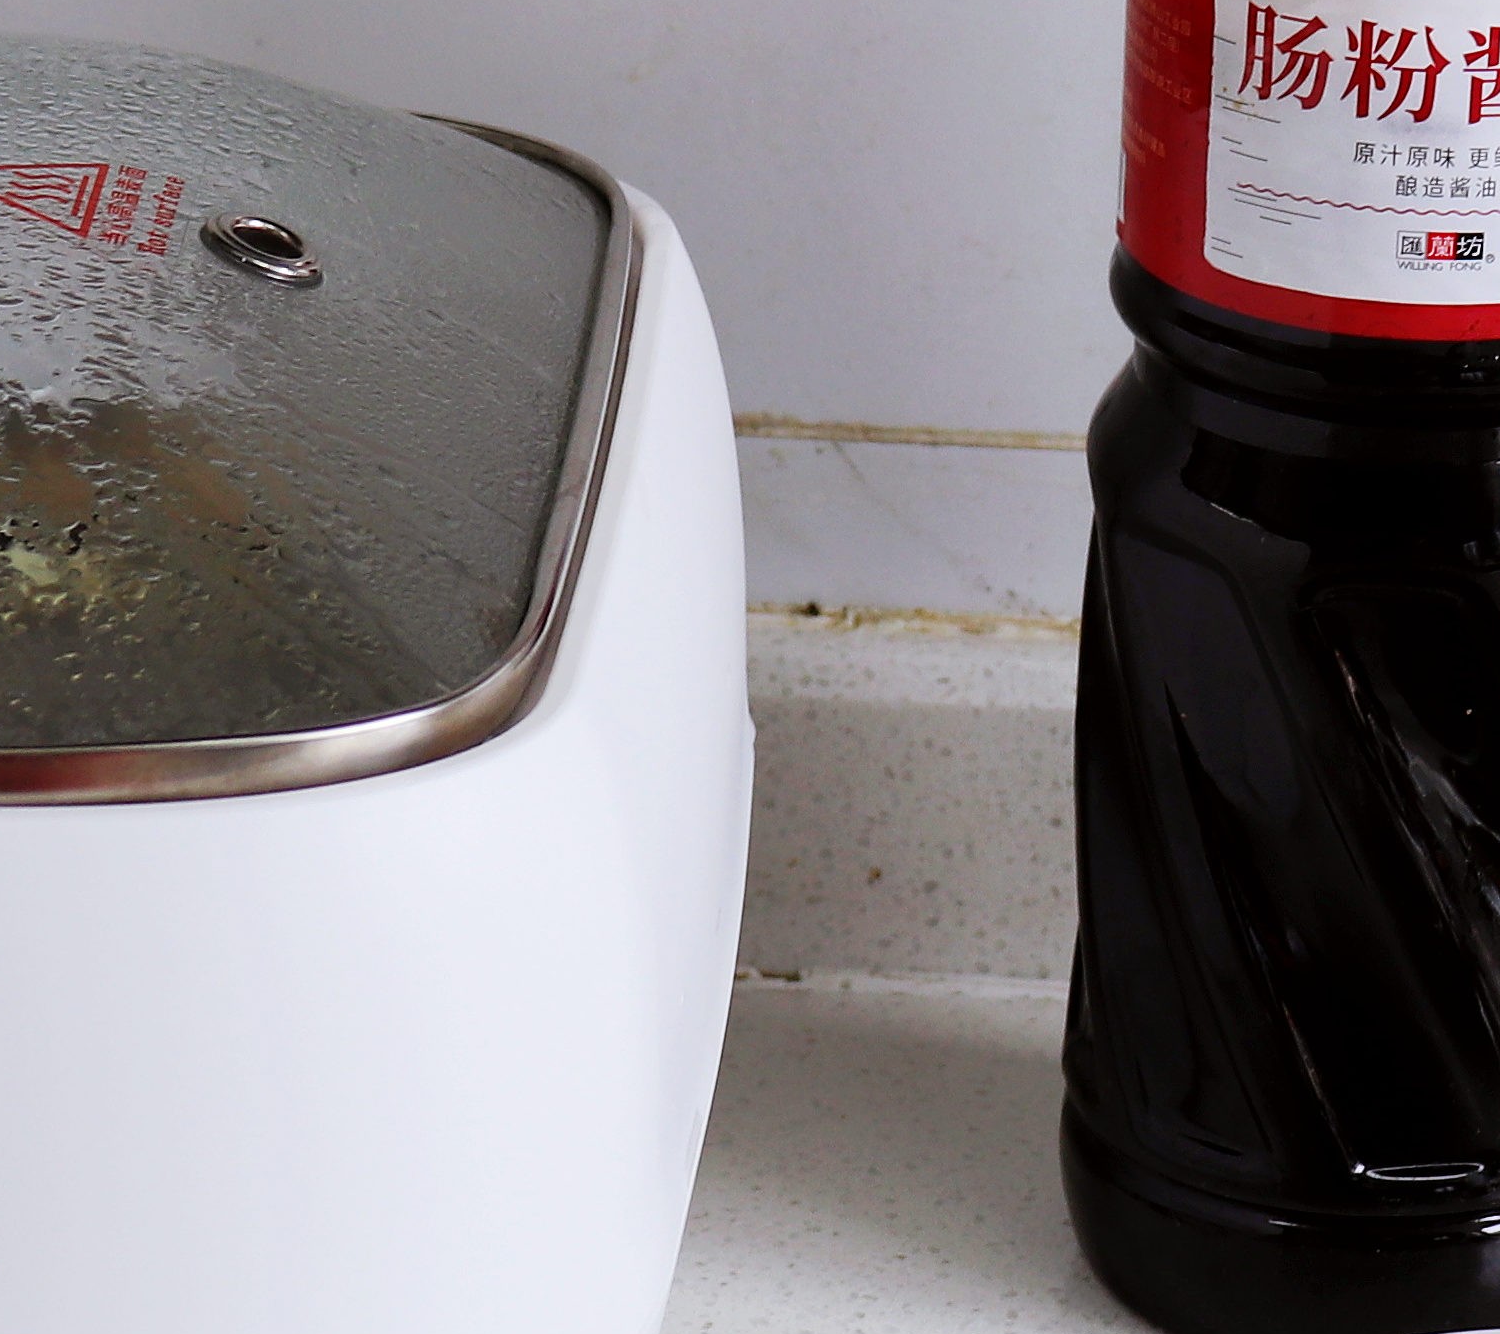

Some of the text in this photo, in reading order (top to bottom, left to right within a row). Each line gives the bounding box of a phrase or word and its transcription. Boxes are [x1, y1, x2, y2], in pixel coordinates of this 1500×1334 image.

[1353, 141, 1456, 169] 原汁原味
[1395, 174, 1497, 199] 酿造酱油
[153, 175, 186, 228] surface
